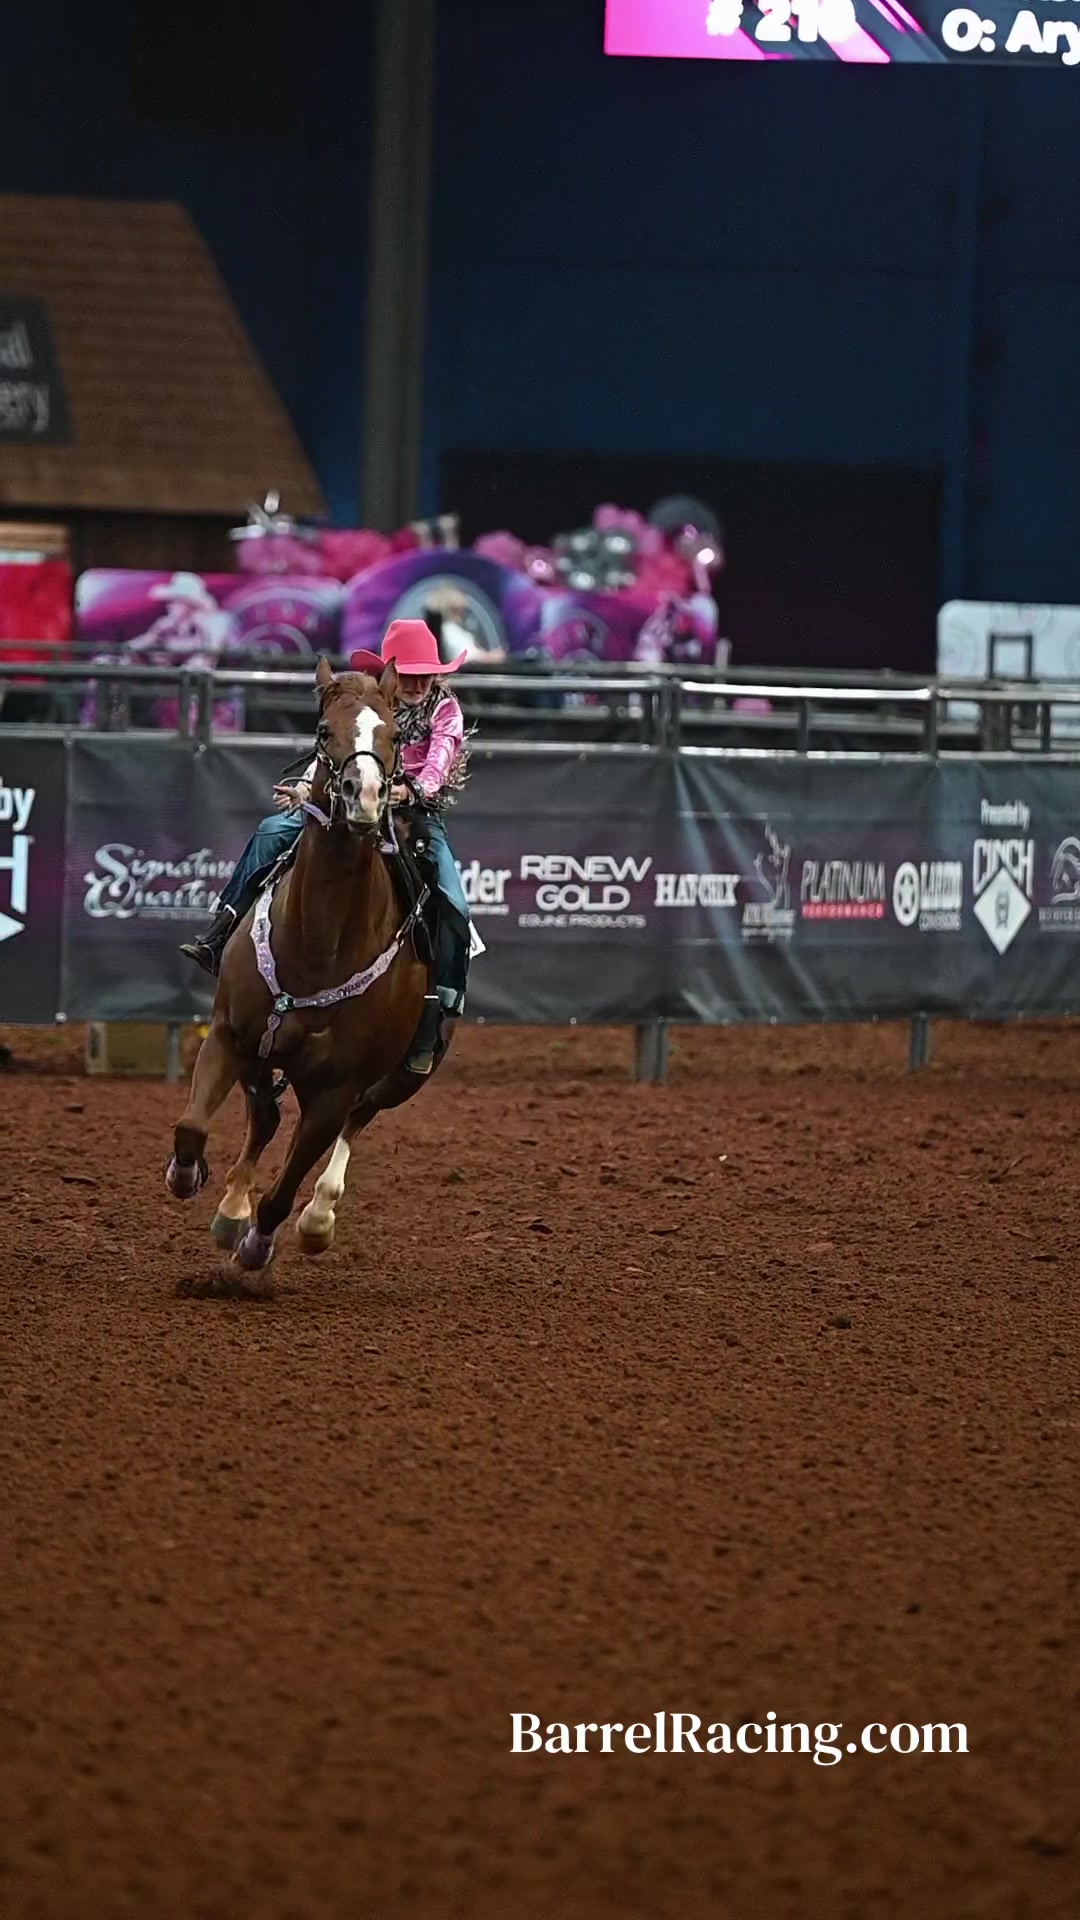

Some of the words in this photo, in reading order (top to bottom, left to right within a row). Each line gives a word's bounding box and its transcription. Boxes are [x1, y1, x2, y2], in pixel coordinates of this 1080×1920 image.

[520, 855, 653, 882] RENEW
[801, 860, 886, 903] PLATINUM
[973, 839, 1034, 897] CINCH
[535, 884, 632, 911] GOLD
[569, 914, 647, 928] PRODUCTS
